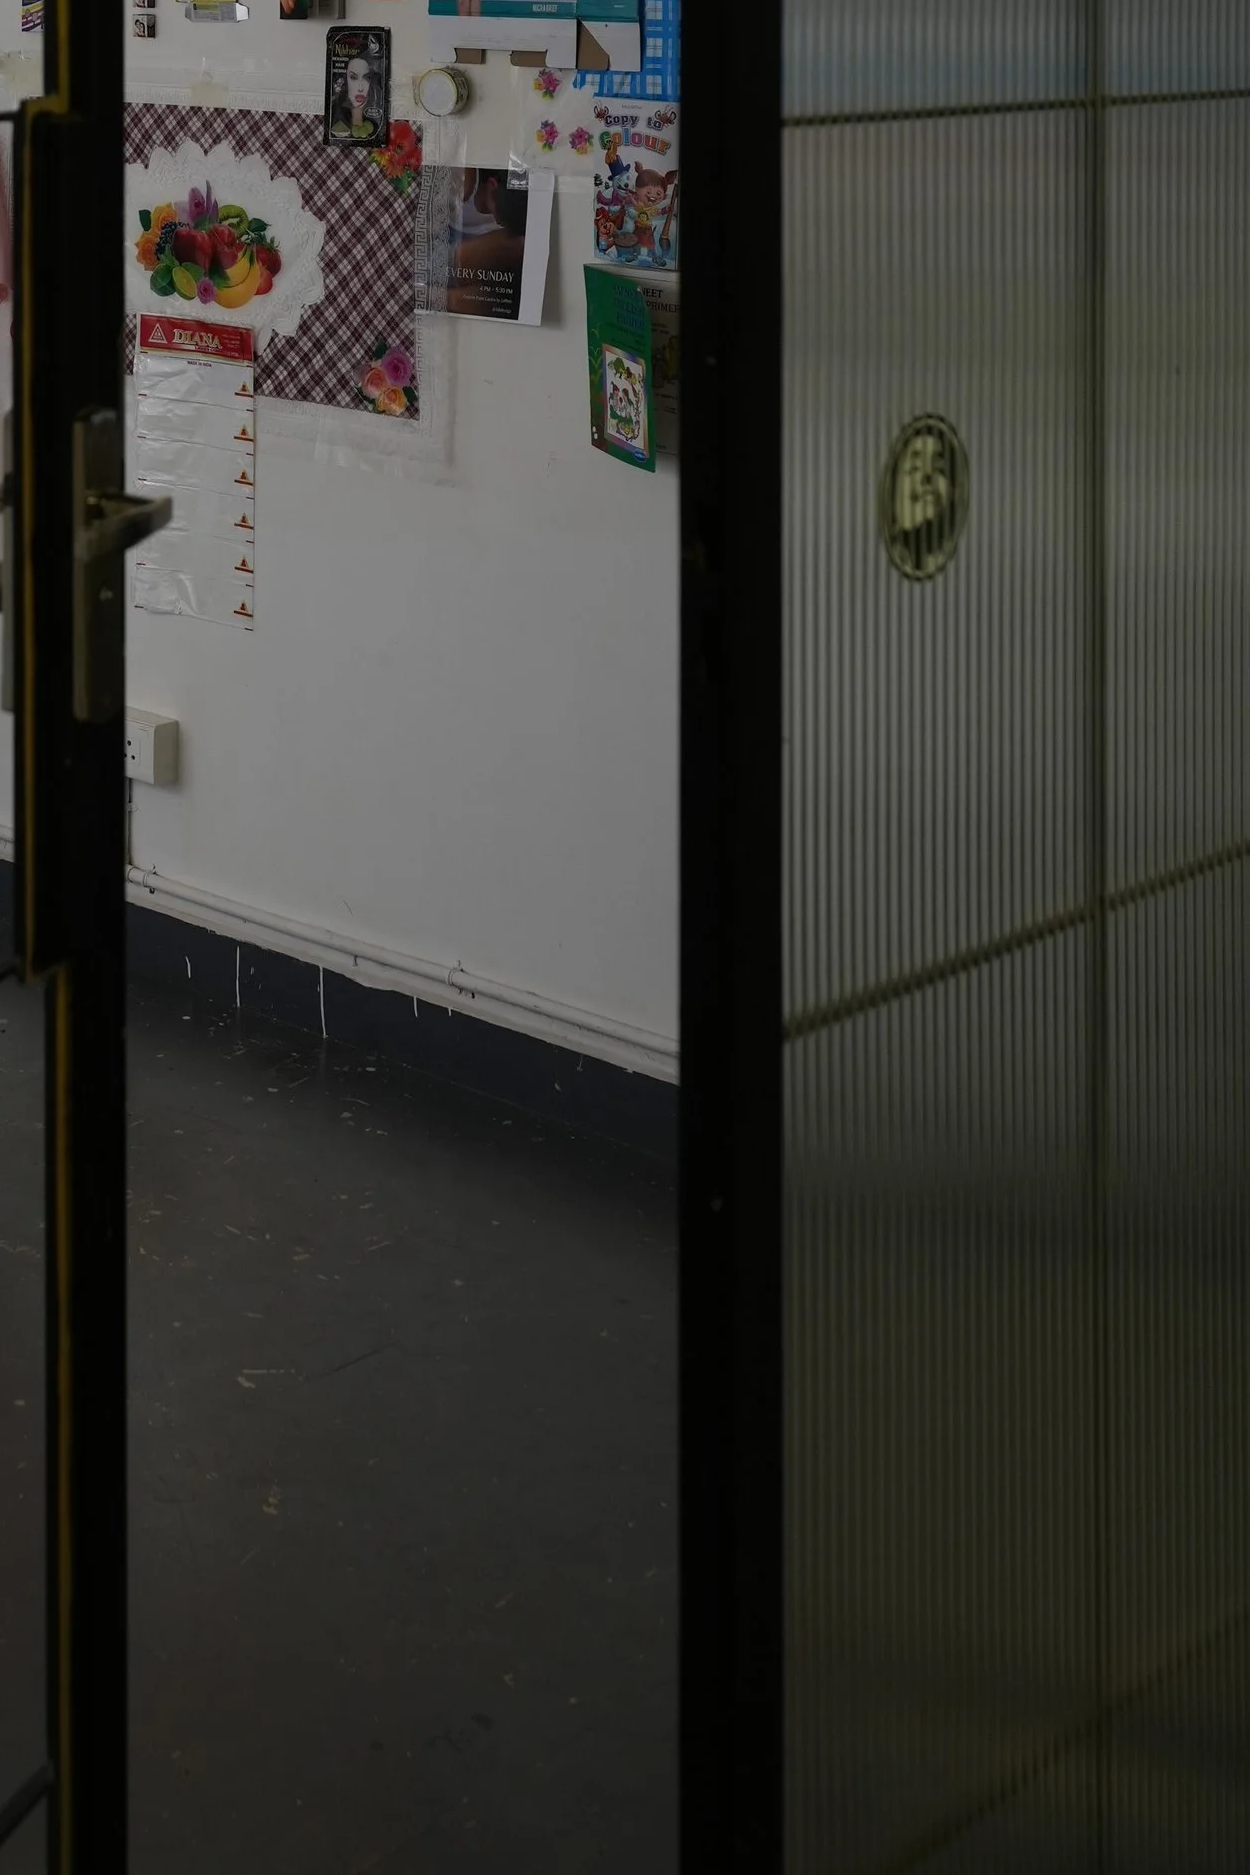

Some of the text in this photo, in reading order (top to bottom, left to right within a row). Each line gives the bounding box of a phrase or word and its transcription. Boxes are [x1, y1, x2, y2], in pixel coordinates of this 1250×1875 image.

[603, 114, 664, 131] Copy to
[598, 127, 672, 156] Colour
[446, 266, 515, 283] EVERY SUNDAY
[172, 328, 223, 350] DIANA
